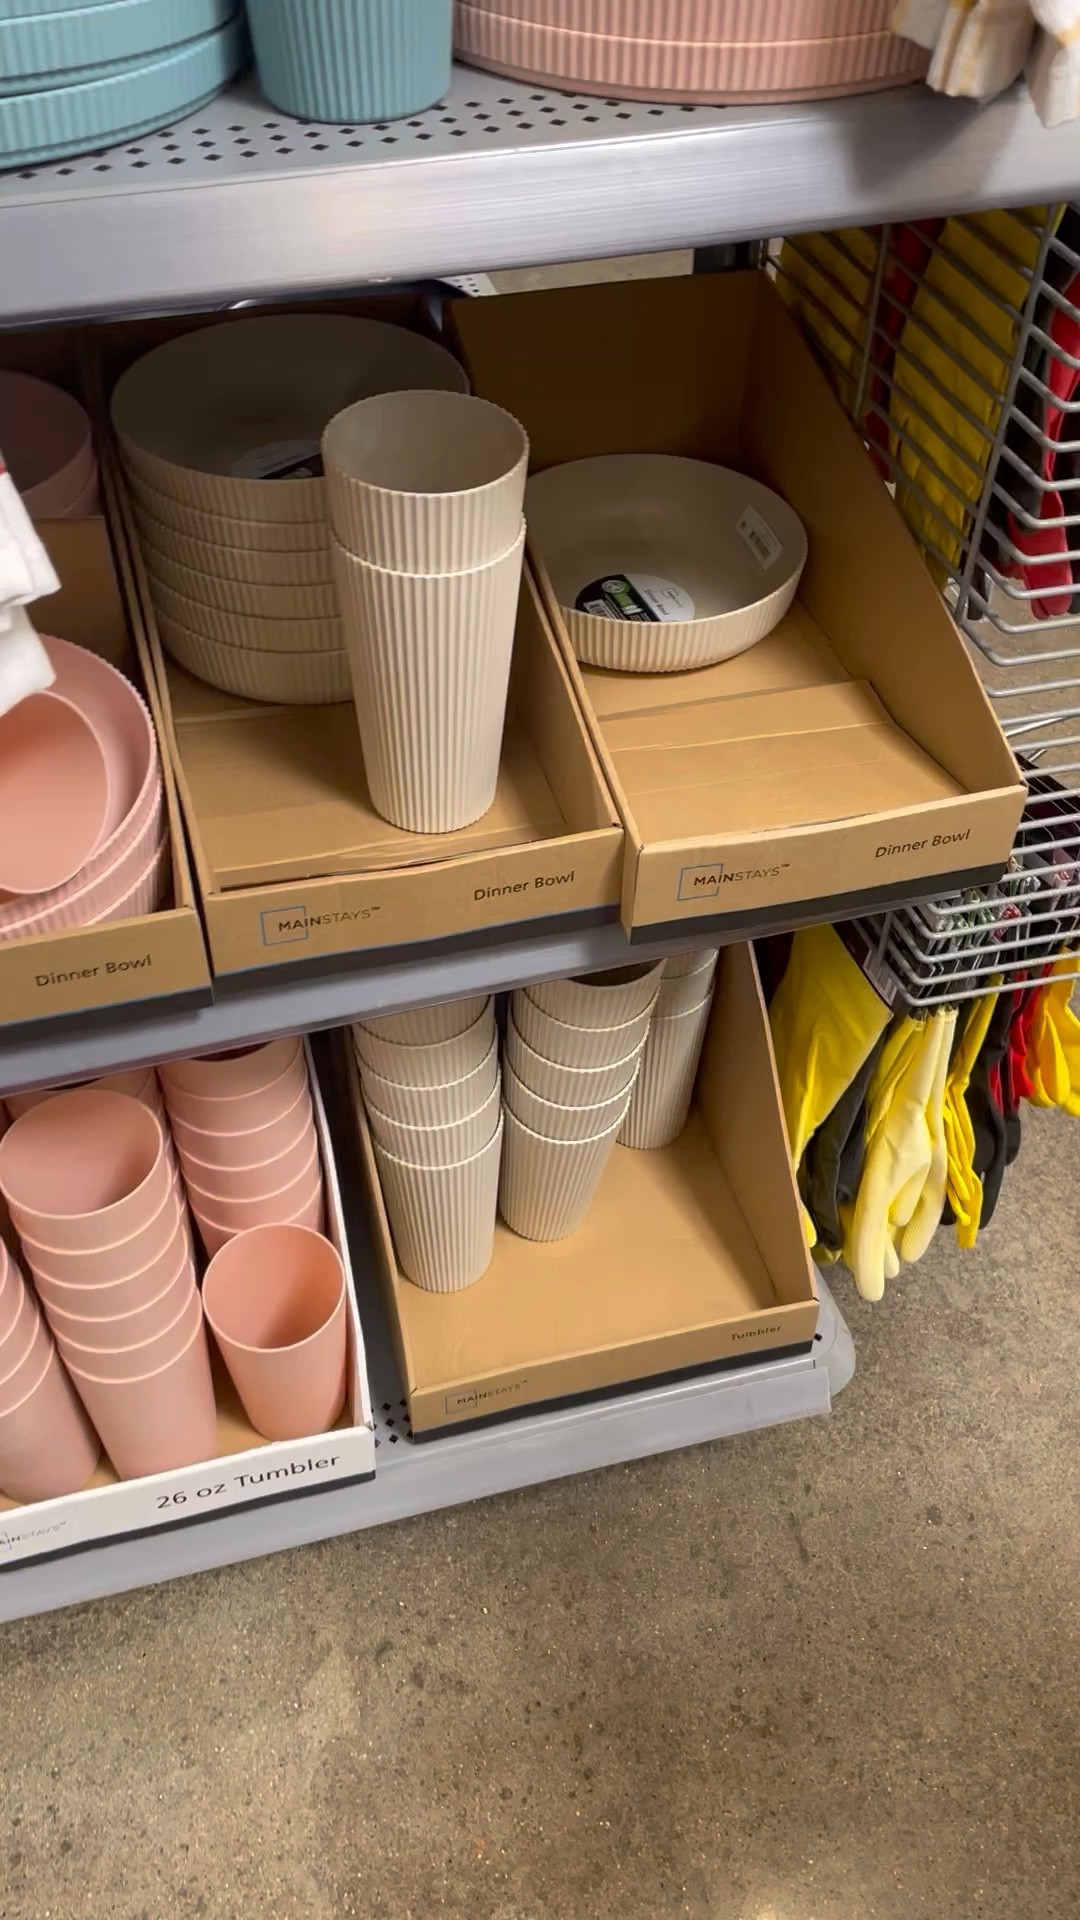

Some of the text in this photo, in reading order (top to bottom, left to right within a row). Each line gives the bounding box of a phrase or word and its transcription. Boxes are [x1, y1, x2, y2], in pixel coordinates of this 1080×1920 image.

[875, 828, 970, 858] Dinner Bowl
[474, 870, 575, 901] Dinner Bowl
[35, 954, 152, 987] Dinner Bowl
[731, 1326, 782, 1340] Tumbler
[156, 1455, 340, 1509] 26 oz Tumbler
